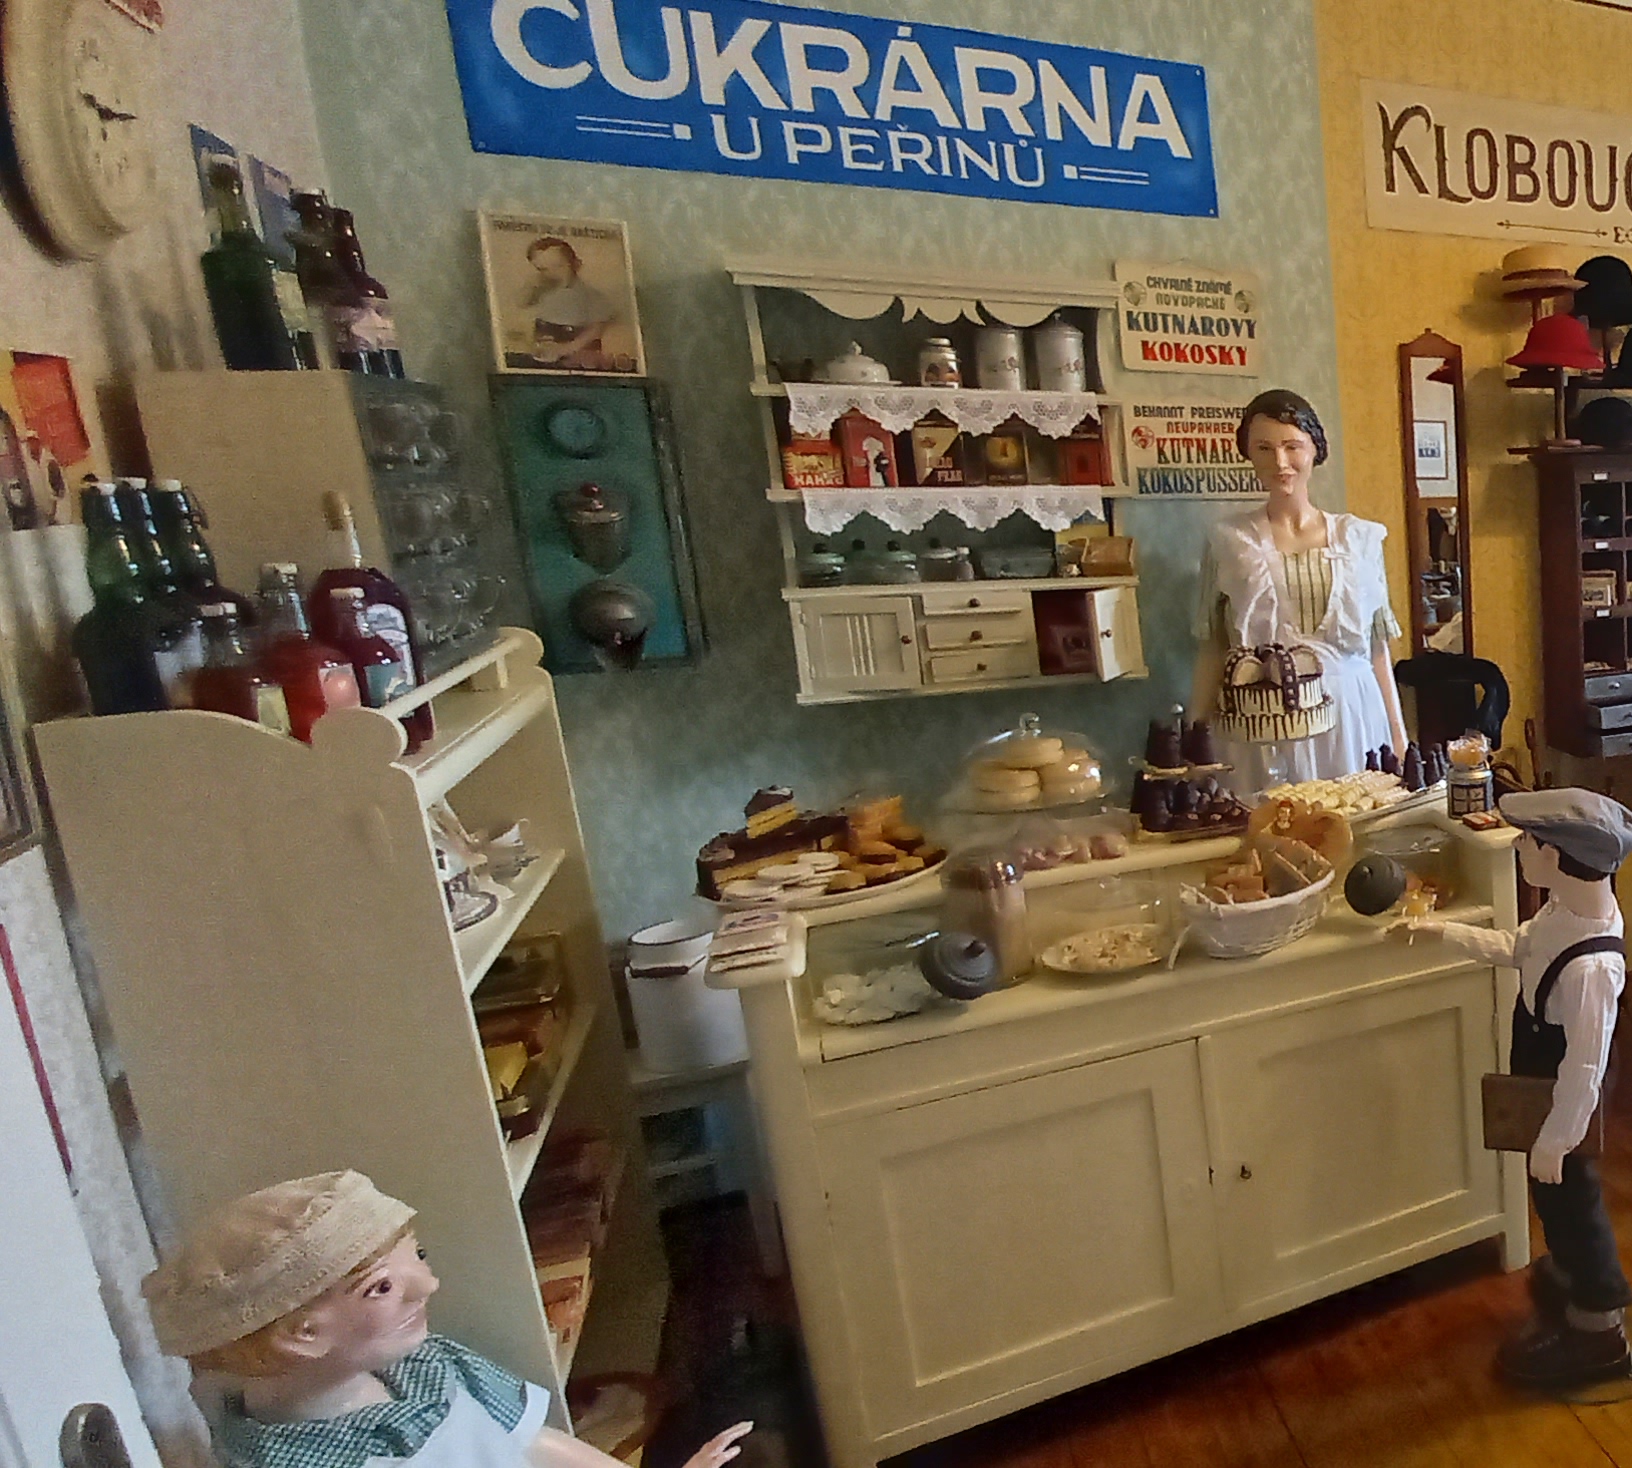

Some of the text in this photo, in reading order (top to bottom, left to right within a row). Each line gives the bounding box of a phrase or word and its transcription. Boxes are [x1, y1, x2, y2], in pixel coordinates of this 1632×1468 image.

[491, 0, 1194, 160] CUKRÁRNA
[713, 113, 1046, 188] U PEŘINŮ
[1140, 340, 1247, 366] KOKOSKY
[1137, 466, 1271, 496] KOKOSPUSSER
